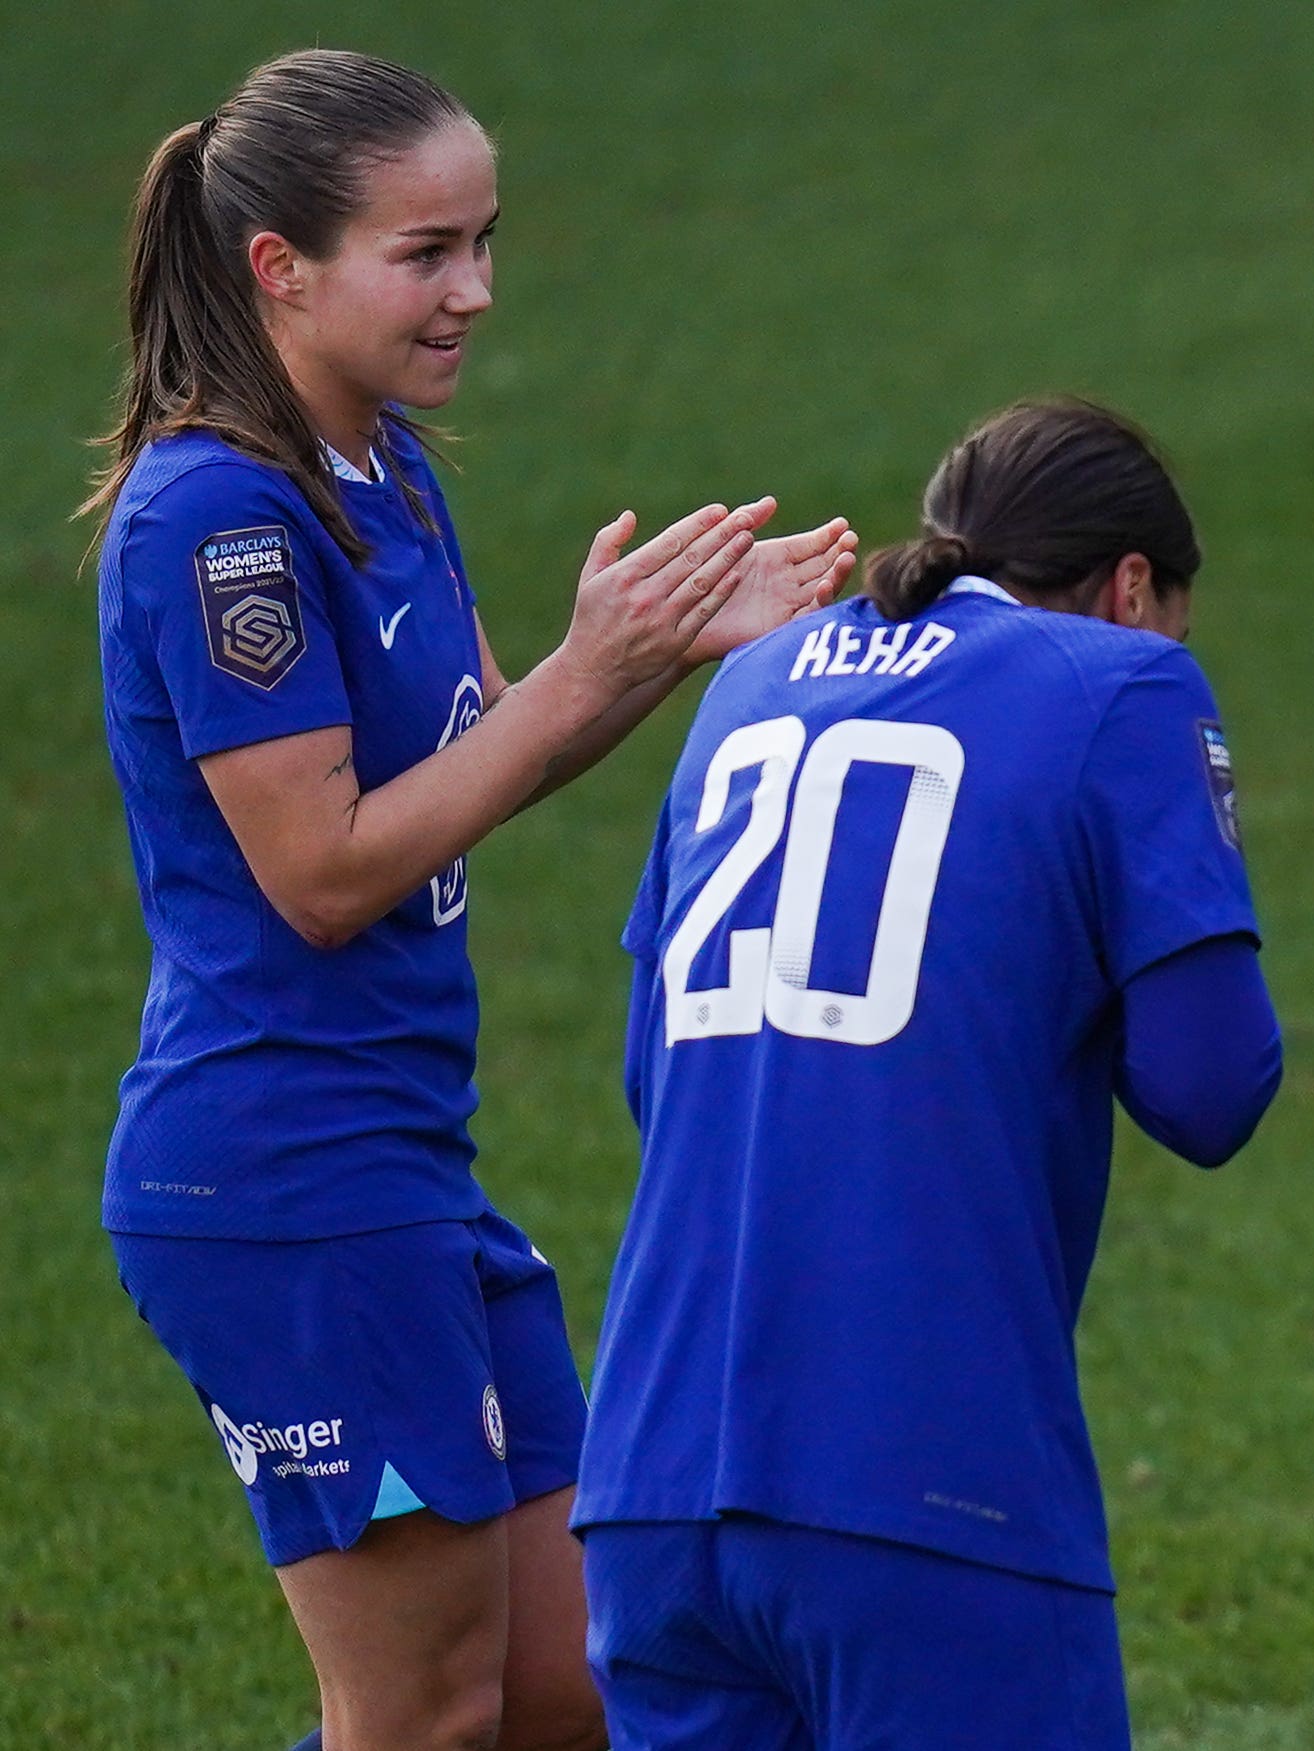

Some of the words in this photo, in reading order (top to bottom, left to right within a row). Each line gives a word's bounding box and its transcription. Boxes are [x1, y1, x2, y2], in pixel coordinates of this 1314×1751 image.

[205, 549, 282, 572] WOMEN'S
[220, 536, 281, 556] BARCLAYS
[208, 568, 245, 582] SUPER
[245, 562, 285, 576] LEAGUE
[788, 620, 957, 682] KEHR
[662, 714, 965, 1048] 20
[241, 1418, 343, 1459] Singer
